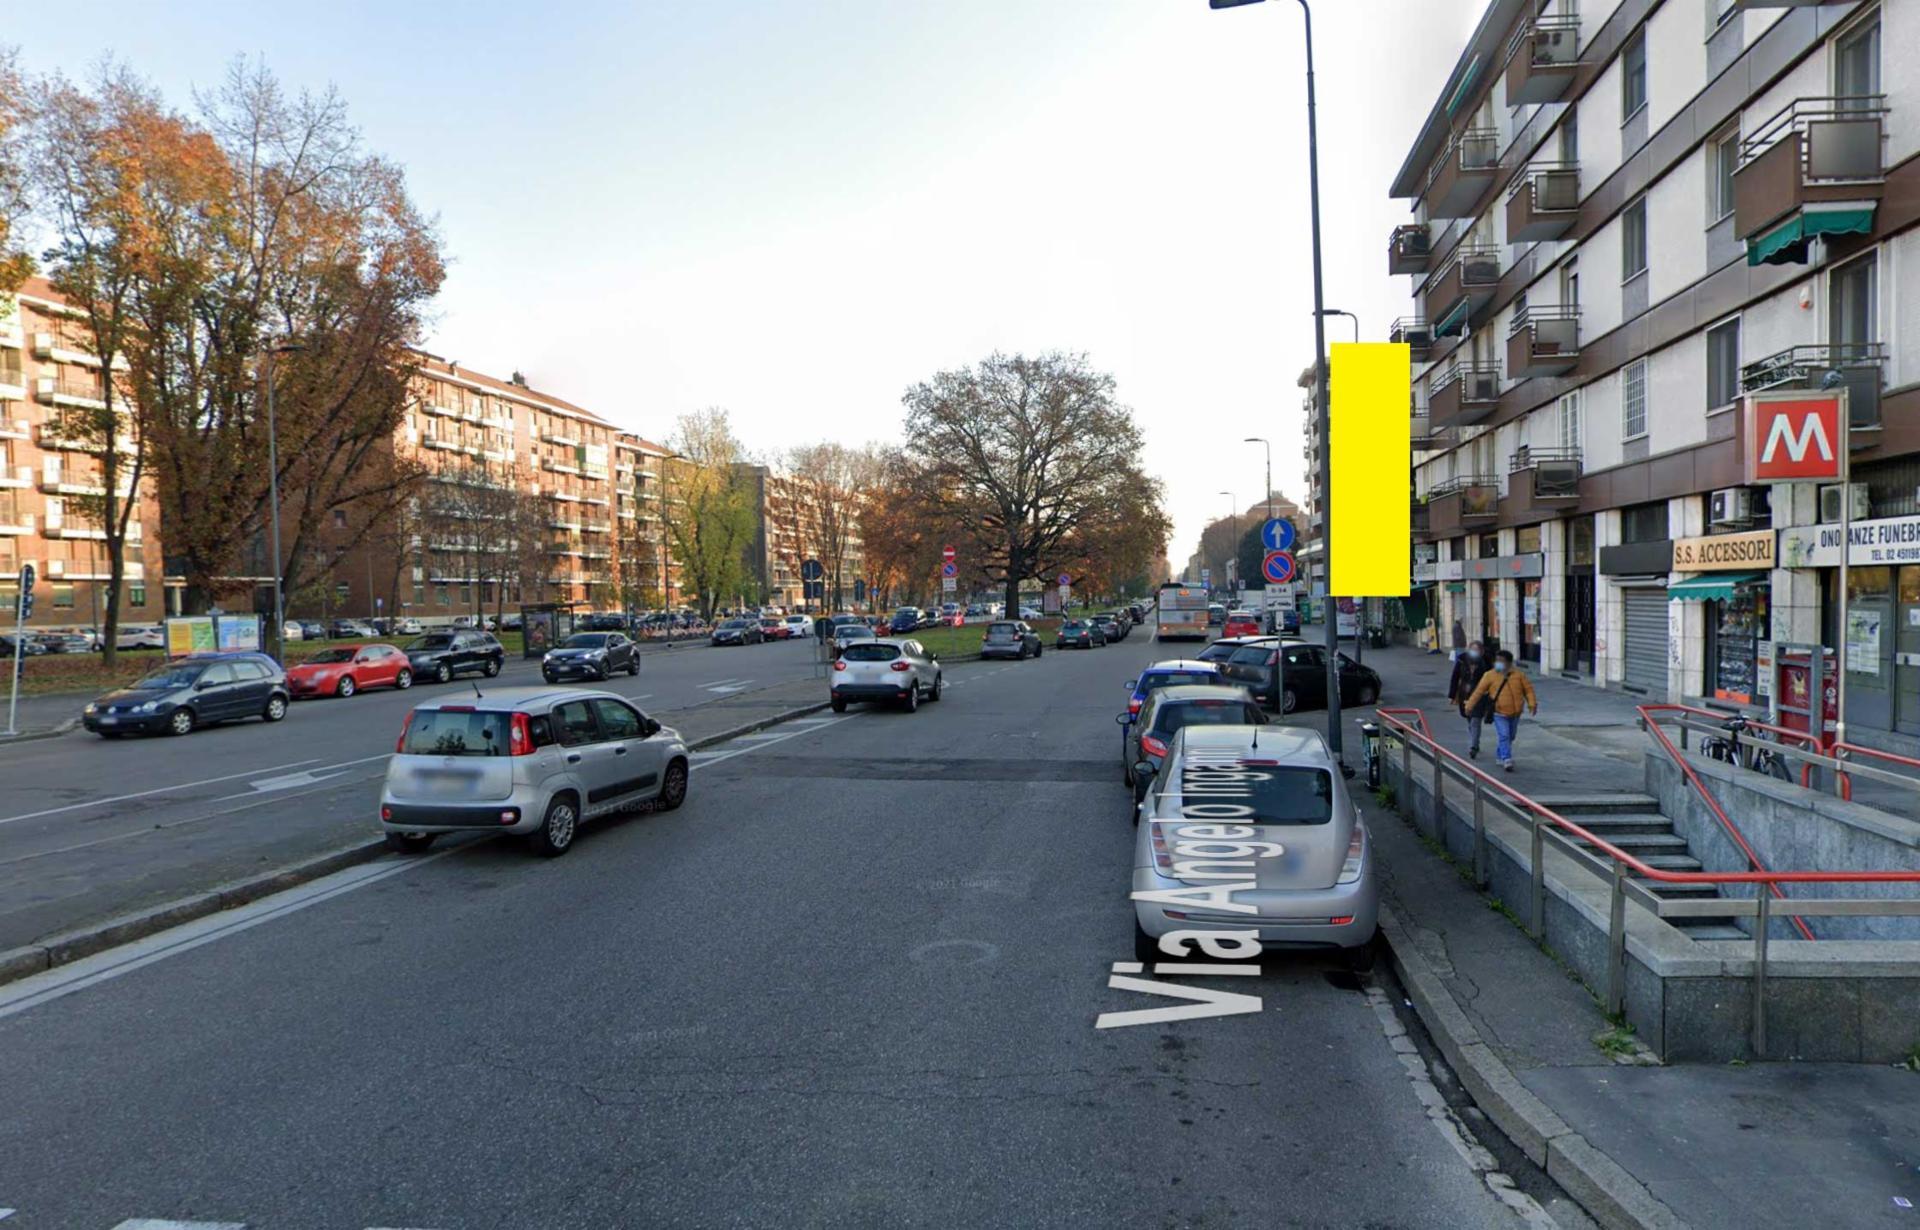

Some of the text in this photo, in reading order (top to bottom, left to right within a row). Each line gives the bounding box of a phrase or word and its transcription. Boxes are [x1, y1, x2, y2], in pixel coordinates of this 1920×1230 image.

[1761, 412, 1834, 463] M
[1675, 539, 1771, 564] S.S. ACCESSORI
